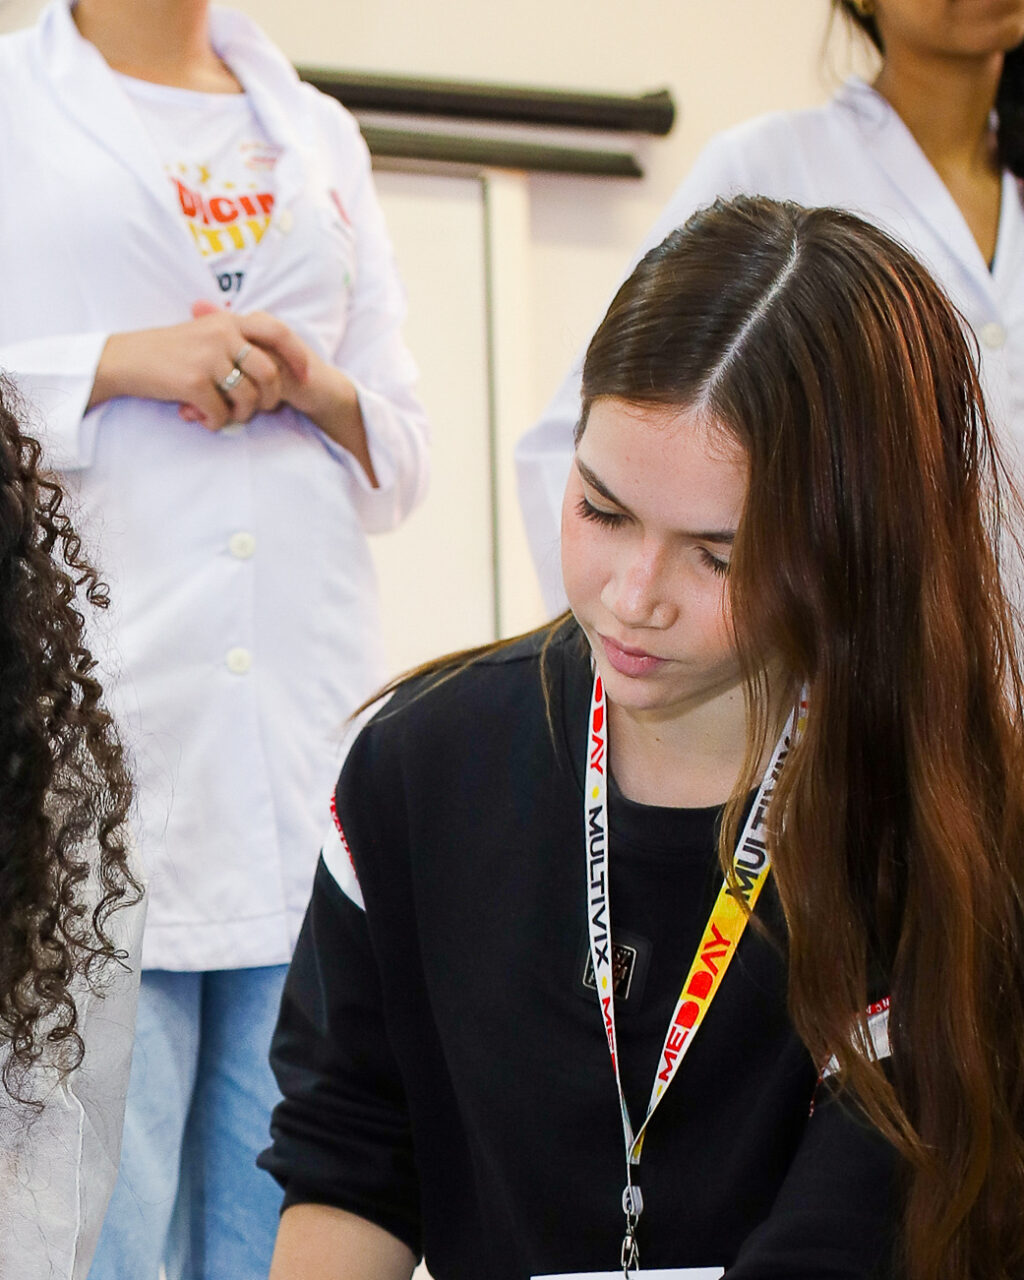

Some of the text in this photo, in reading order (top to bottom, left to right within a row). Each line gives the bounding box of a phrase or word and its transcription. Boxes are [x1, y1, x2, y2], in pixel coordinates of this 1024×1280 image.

[589, 805, 610, 969] MULTIVIX
[658, 922, 731, 1082] MED DAY
